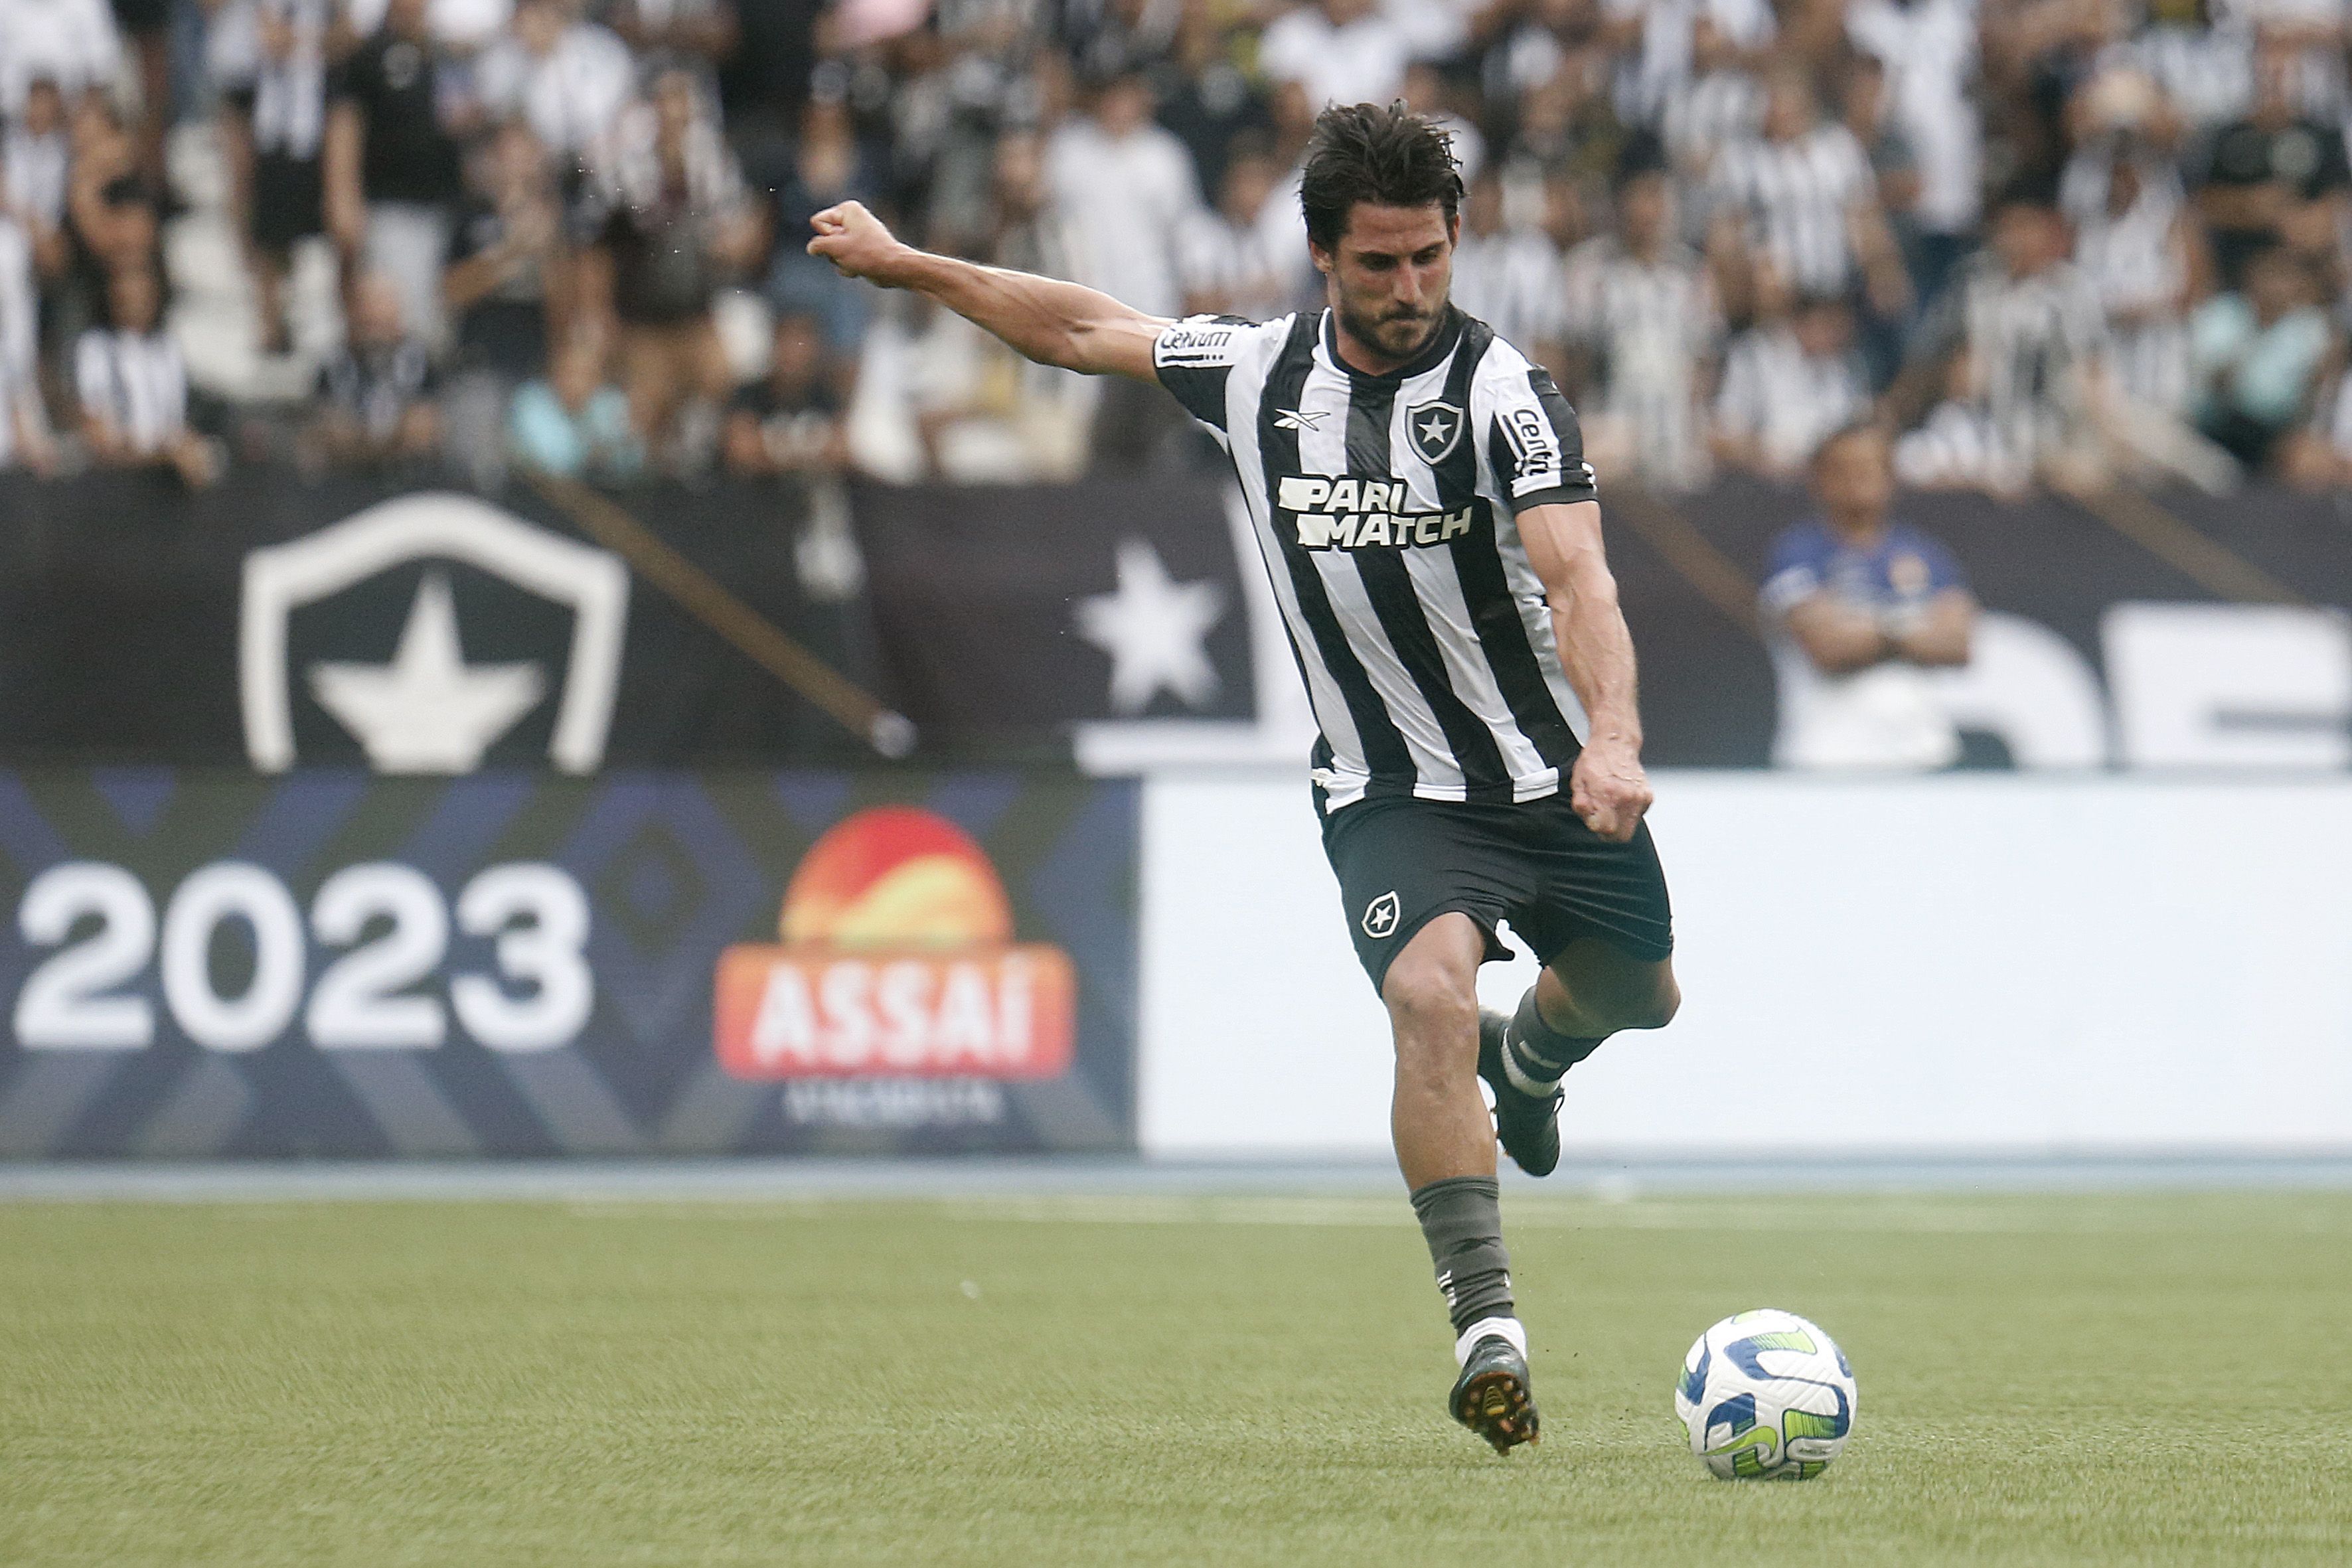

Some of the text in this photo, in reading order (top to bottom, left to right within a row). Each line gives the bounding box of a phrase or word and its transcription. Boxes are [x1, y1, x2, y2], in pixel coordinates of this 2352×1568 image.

[1279, 477, 1404, 514] PARI
[1296, 506, 1473, 547] MATCH
[13, 860, 595, 1053] 2023
